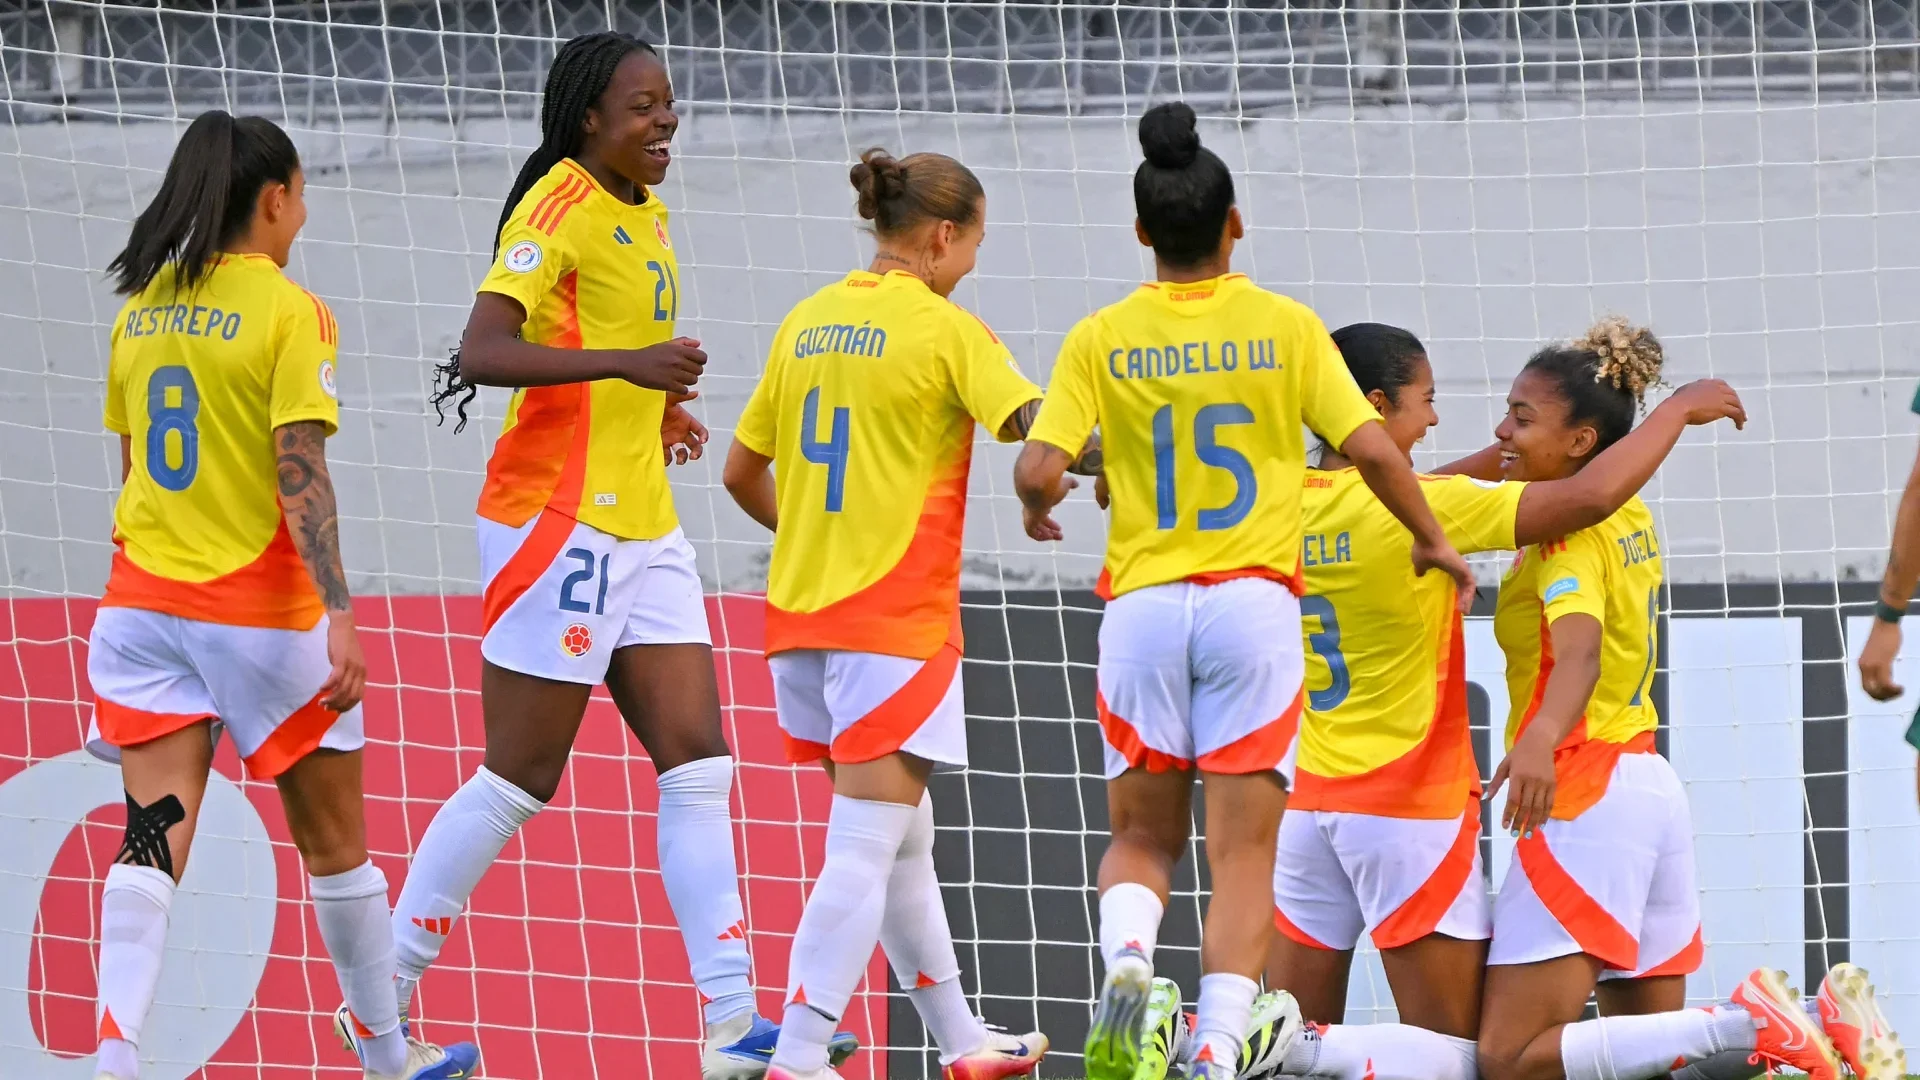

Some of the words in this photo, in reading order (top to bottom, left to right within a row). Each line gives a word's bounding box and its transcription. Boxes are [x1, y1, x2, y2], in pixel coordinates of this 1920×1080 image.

[646, 260, 677, 321] 21
[124, 304, 242, 341] RESTREPO
[795, 320, 887, 358] GUZMÁN
[1109, 341, 1238, 379] CANDELO
[1248, 339, 1284, 371] W.
[146, 365, 200, 491] 8
[801, 385, 850, 513] 4
[1152, 403, 1258, 531] 15
[1303, 477, 1333, 489] LOMBIA
[1303, 531, 1351, 567] ELA
[558, 547, 610, 615] 21
